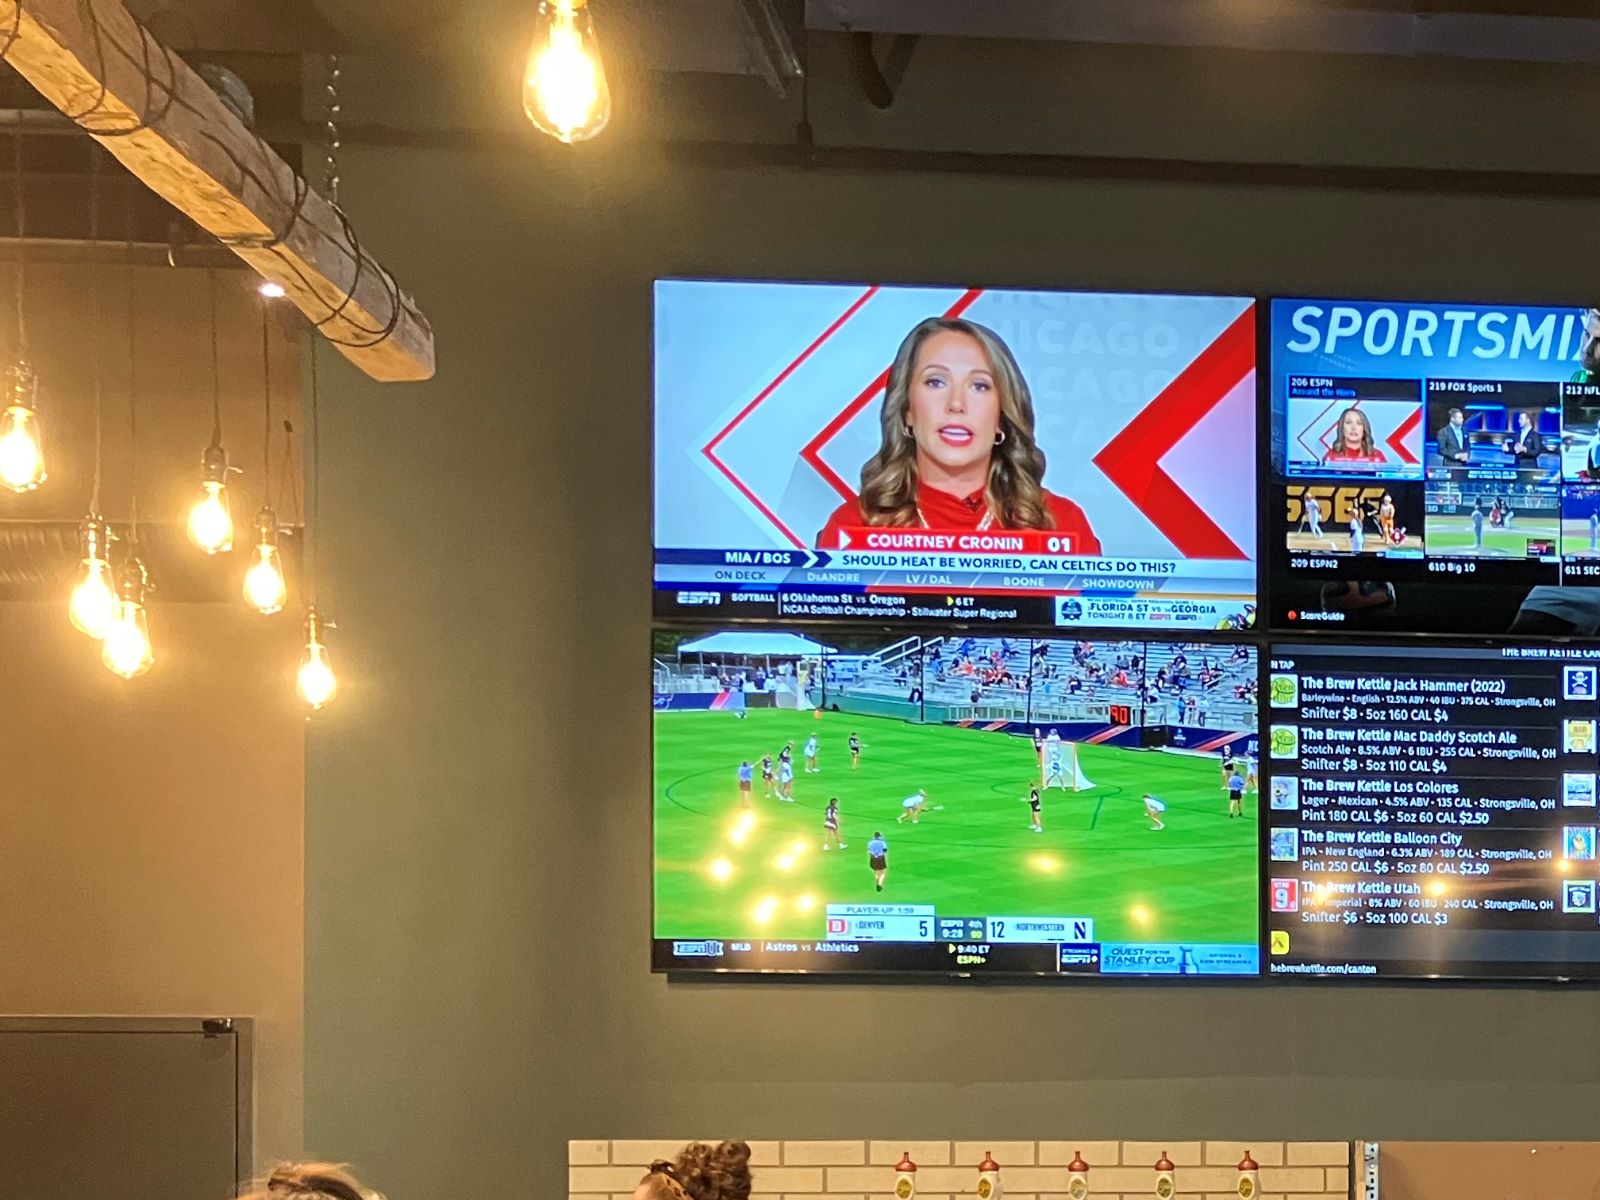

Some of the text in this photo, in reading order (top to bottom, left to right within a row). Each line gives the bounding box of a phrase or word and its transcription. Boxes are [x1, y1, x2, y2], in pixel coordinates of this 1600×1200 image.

[1291, 377, 1333, 387] 206 ESPN
[1429, 381, 1446, 391] 219
[1448, 382, 1466, 391] FOX
[1467, 382, 1495, 393] Sports
[1566, 386, 1582, 395] 212
[1584, 386, 1600, 395] NFL
[867, 533, 1071, 552] COURTNEY CRONIN 01
[843, 554, 1176, 574] SHOULD HEAT BE WORRIED, CAN CELTICS DO THIS?
[1291, 558, 1338, 569] 209 ESPN2
[1429, 563, 1475, 574] 610 Big 10
[715, 571, 766, 580] ON DECK
[1565, 566, 1600, 575] 611 SEC
[1003, 576, 1045, 587] BOONE
[1082, 578, 1154, 590] SHOWDOWN
[677, 592, 720, 604] ESPN
[731, 593, 775, 602] SOFTBALL
[790, 593, 840, 603] Oklahoma
[841, 593, 852, 603] St
[869, 594, 906, 605] Oregon
[1090, 603, 1133, 612] FLORIDA
[1171, 605, 1216, 613] GEORGIA
[1300, 611, 1345, 621] ScoreGuide
[1302, 677, 1505, 694] The Brew Kettle Jack Hammer (2022)
[1302, 706, 1448, 722] Snifter $8 5oz 160 CAL $4
[1302, 728, 1517, 745] The Brew Kettle Mac Daddy Scotch Ale
[1302, 744, 1334, 754] Scotch
[1335, 745, 1351, 754] Ale
[1358, 746, 1380, 755] 8.5%
[1382, 746, 1401, 755] ABV
[1416, 746, 1433, 756] IBU
[1458, 747, 1475, 756] CAL
[1483, 747, 1540, 760] Strongsville,
[1543, 748, 1556, 758] OH
[919, 920, 928, 938] 5
[991, 921, 1005, 938] 12
[1074, 921, 1086, 939] N
[766, 942, 797, 952] Astros
[815, 943, 859, 953] Athletics
[1111, 948, 1144, 956] QUEST
[1104, 956, 1151, 965] STANLEY
[1154, 956, 1175, 965] CUP
